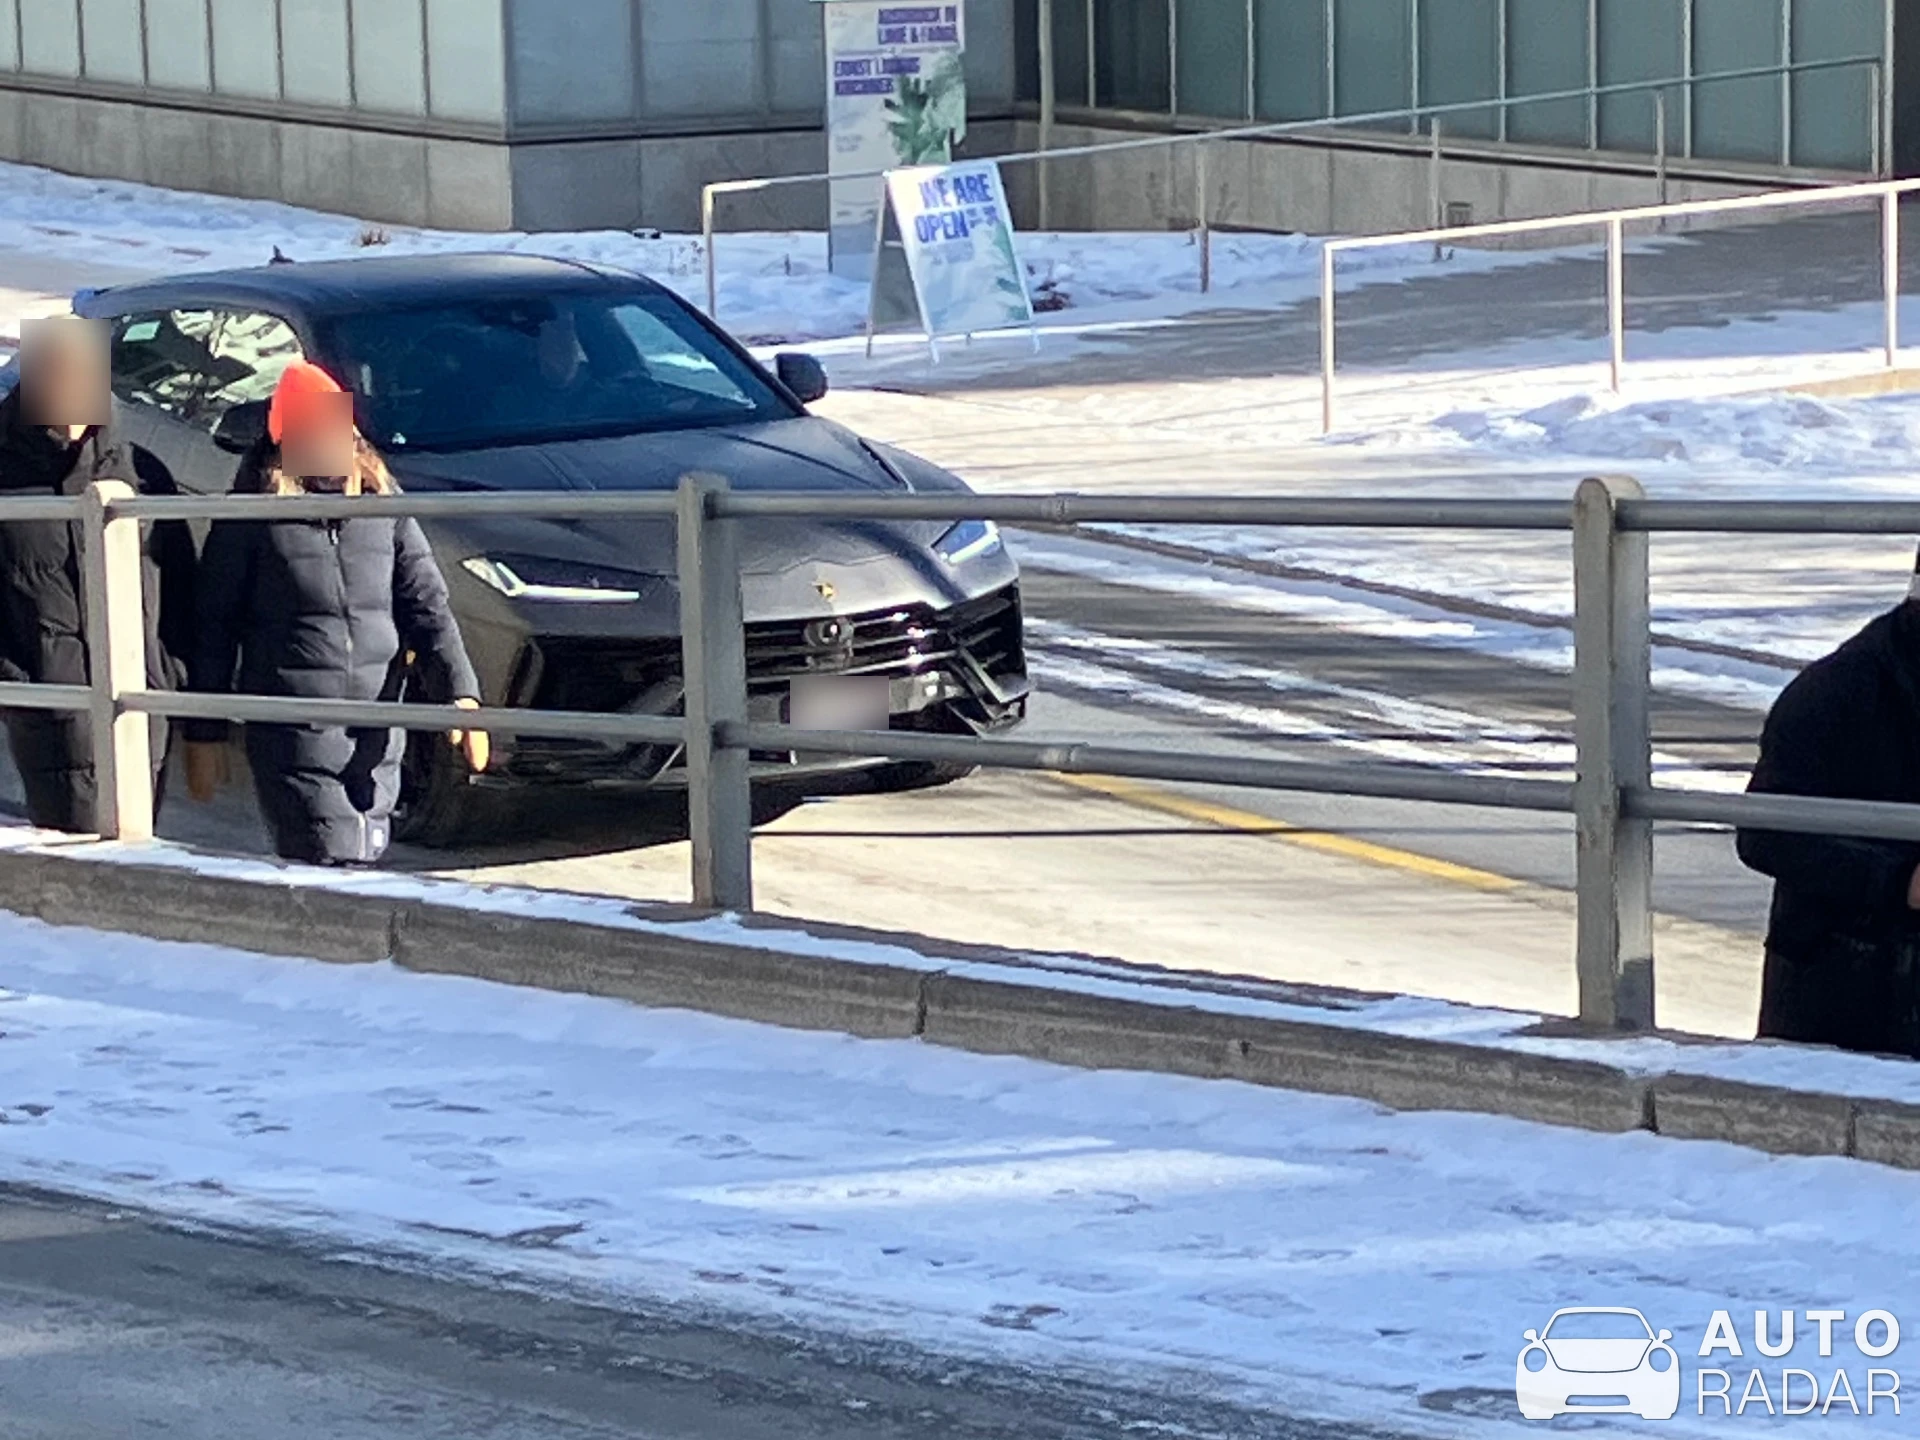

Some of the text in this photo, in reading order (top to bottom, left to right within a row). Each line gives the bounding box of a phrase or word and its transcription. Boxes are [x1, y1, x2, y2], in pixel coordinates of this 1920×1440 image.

[918, 173, 994, 208] WE ARE
[915, 210, 969, 244] OPEN
